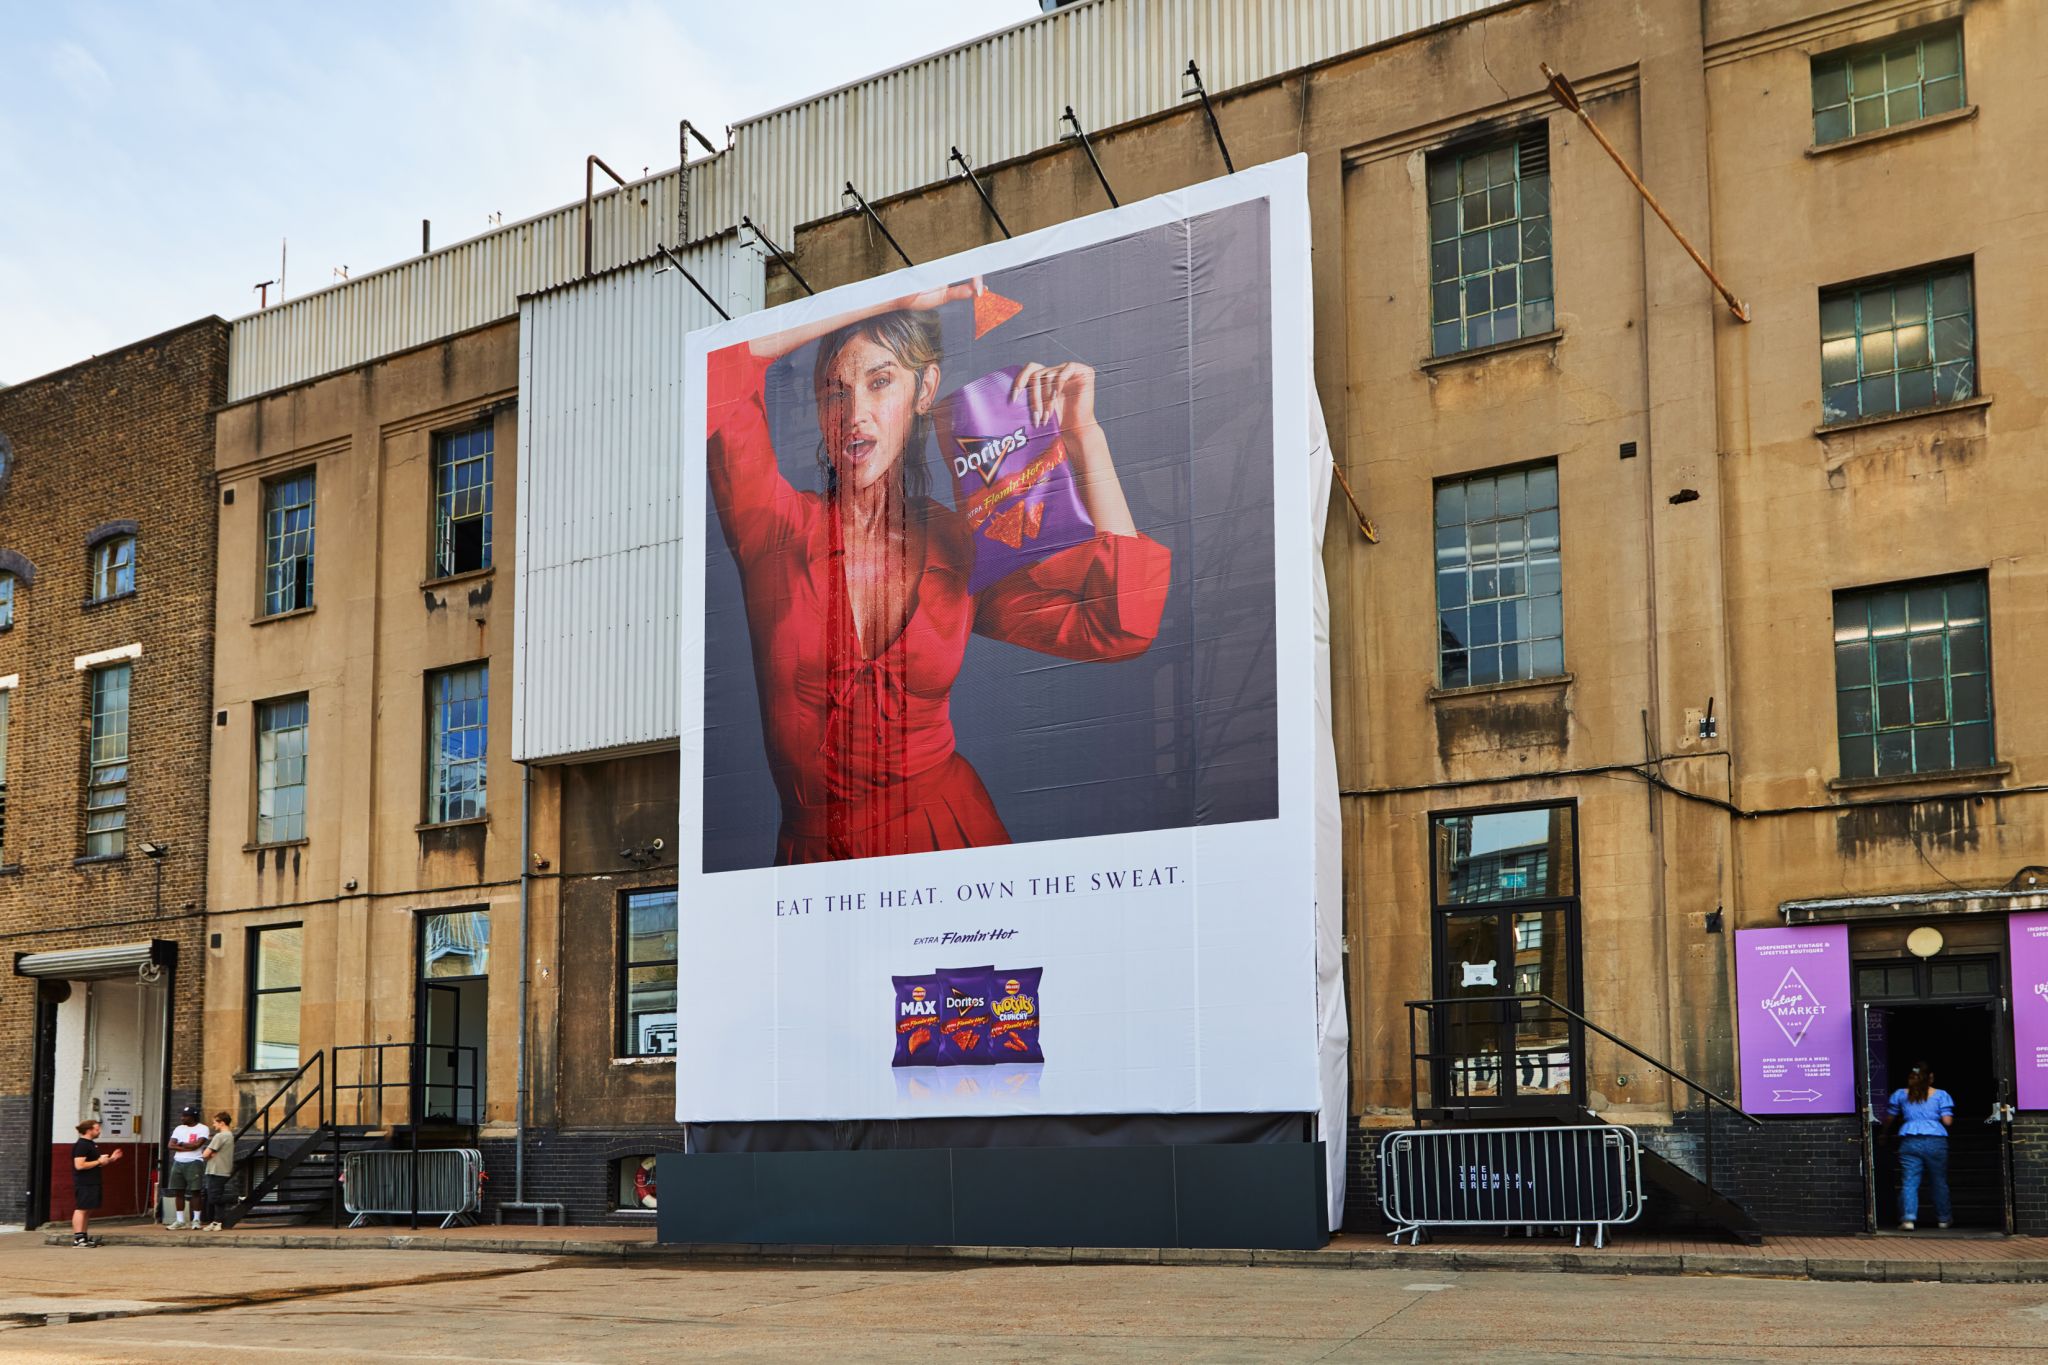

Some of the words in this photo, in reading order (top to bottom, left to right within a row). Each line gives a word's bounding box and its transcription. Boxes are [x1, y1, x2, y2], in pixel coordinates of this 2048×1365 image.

[953, 428, 1027, 478] Doritos
[966, 504, 983, 519] XTRA
[1020, 461, 1044, 485] Hot
[776, 897, 813, 917] EAT
[824, 892, 867, 912] THE
[879, 887, 943, 908] HEAT.
[957, 880, 1014, 902] OWN
[1028, 875, 1076, 896] THE
[1091, 866, 1185, 891] SWEAT.
[913, 936, 939, 946] EXTRA
[989, 928, 1019, 941] Hot
[1755, 943, 1796, 952] INDEPENDENT
[901, 1000, 937, 1016] MAX
[946, 997, 985, 1008] Doritos
[1761, 994, 1804, 1010] Vintage
[999, 1012, 1029, 1021] CRUNCHY
[1778, 1005, 1827, 1016] MARKET
[1459, 1165, 1487, 1173] THE
[1459, 1173, 1521, 1181] TRUMAN
